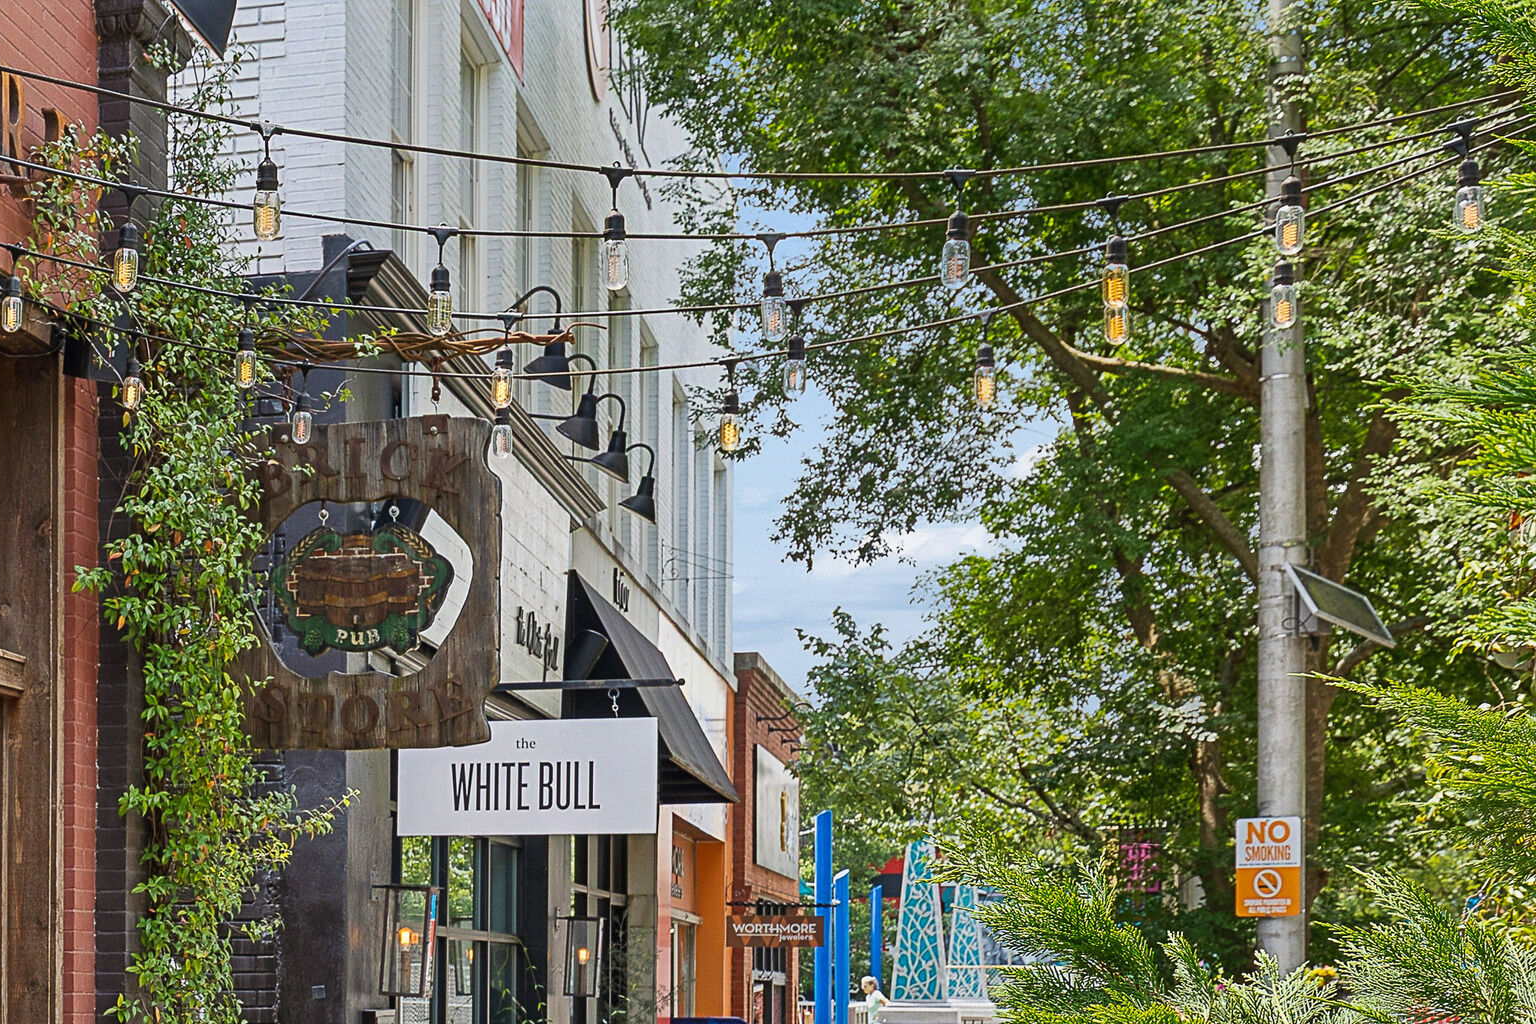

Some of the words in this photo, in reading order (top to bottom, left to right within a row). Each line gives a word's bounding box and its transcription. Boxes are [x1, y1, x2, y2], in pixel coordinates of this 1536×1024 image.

[261, 437, 472, 500] BRICK
[335, 629, 381, 646] PUB
[253, 676, 474, 735] STORE
[515, 738, 537, 750] the
[451, 761, 530, 812] WHITE
[539, 760, 601, 810] BULL
[1245, 820, 1291, 844] NO
[1244, 845, 1291, 862] SMOKING
[732, 923, 817, 934] WORTHMORE
[778, 932, 814, 942] jewelers
